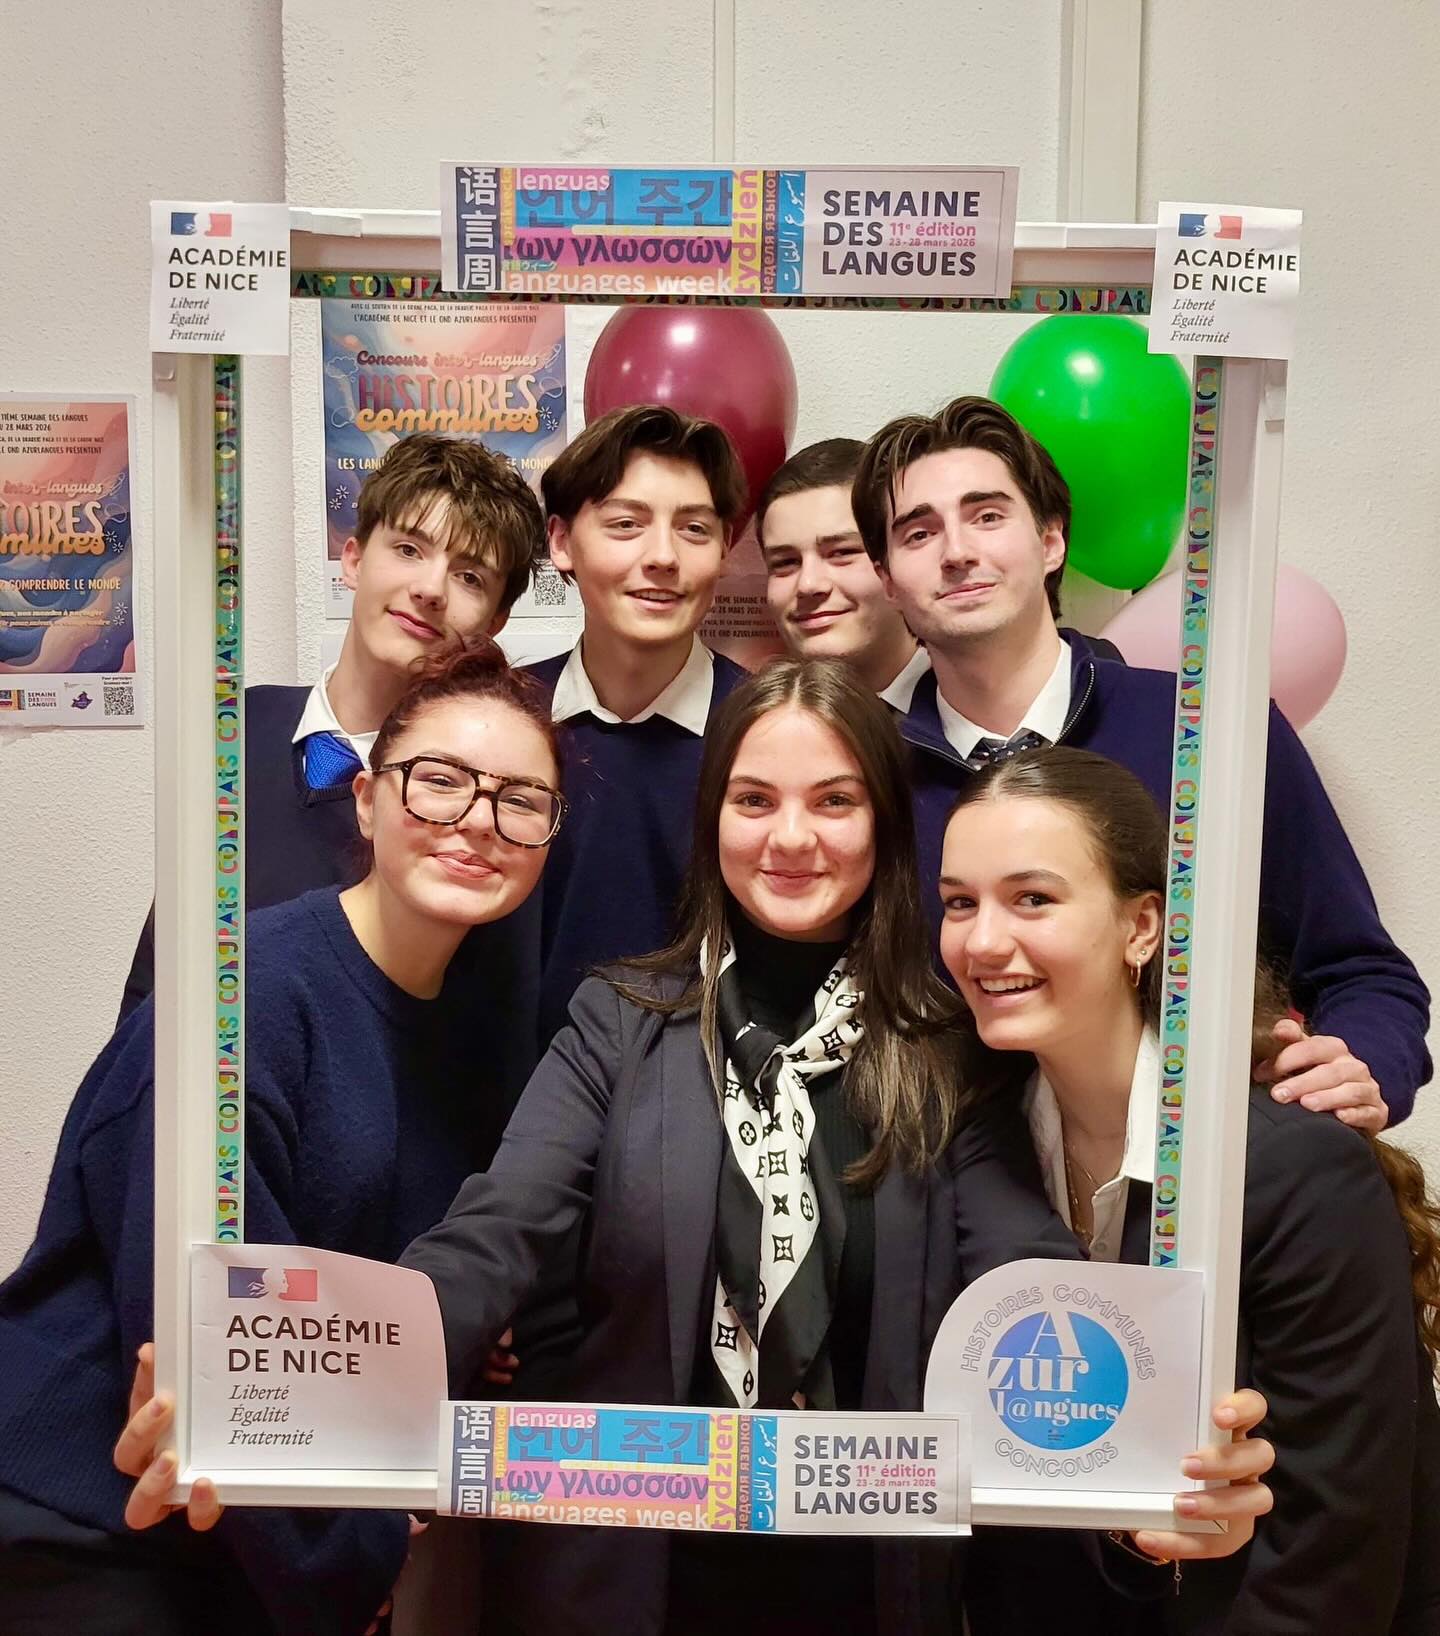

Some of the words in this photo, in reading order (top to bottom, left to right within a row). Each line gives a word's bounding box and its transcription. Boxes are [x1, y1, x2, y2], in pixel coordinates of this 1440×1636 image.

[516, 168, 610, 191] lenguas
[636, 176, 733, 227] 주간
[823, 190, 980, 217] SEMAINE
[459, 167, 498, 290] 语言周
[732, 170, 761, 294] tydzień
[823, 222, 883, 247] DES
[916, 222, 976, 237] édition
[571, 235, 732, 266] γλωσσών
[889, 239, 901, 247] 23
[950, 239, 976, 247] 2026
[168, 245, 287, 267] ACADÉMIE
[778, 231, 801, 290] اللغات
[822, 251, 977, 277] LANGUES
[1174, 248, 1297, 271] ACADÉMIE
[169, 271, 197, 289] DE
[205, 273, 259, 291] NICE
[501, 270, 646, 294] languages
[655, 269, 733, 294] week
[1173, 273, 1203, 290] DE
[1211, 274, 1267, 293] NICE
[169, 297, 210, 310] Liberté
[1172, 299, 1216, 311] Liberté
[168, 311, 210, 327] Égalité
[420, 315, 428, 323] ET
[429, 315, 437, 323] LE
[1170, 312, 1215, 329] Égalité
[169, 328, 226, 342] Fraternité
[1170, 330, 1231, 343] Fraternité
[357, 350, 428, 367] Concours
[62, 414, 89, 422] LANGUES
[355, 407, 540, 433] communes
[337, 457, 356, 470] LES
[9, 578, 71, 591] COMPRENDRE
[74, 579, 85, 590] LE
[88, 579, 121, 590] MONDE
[226, 1313, 401, 1345] ACADÉMIE
[960, 1286, 1044, 1373] HISTOIRES
[1052, 1283, 1157, 1381] COMMUNES
[228, 1348, 270, 1373] DE
[283, 1350, 361, 1375] NICE
[228, 1383, 290, 1400] Liberté
[228, 1404, 290, 1427] Égalité
[509, 1407, 597, 1429] lenguas
[228, 1429, 314, 1446] Fraternité
[620, 1417, 710, 1465] 주간
[794, 1434, 938, 1460] SEMAINE
[456, 1406, 492, 1515] 语言周
[994, 1438, 1119, 1478] CONCOURS
[710, 1413, 737, 1531] tydzień
[795, 1464, 851, 1487] DES
[881, 1464, 936, 1478] édition
[558, 1469, 709, 1500] γλωσσών
[856, 1479, 868, 1487] 23
[874, 1479, 886, 1487] 28
[913, 1479, 936, 1487] 2026
[753, 1471, 774, 1528] اللغات
[794, 1491, 938, 1515] LANGUES
[491, 1501, 627, 1525] languages
[636, 1502, 710, 1529] week
